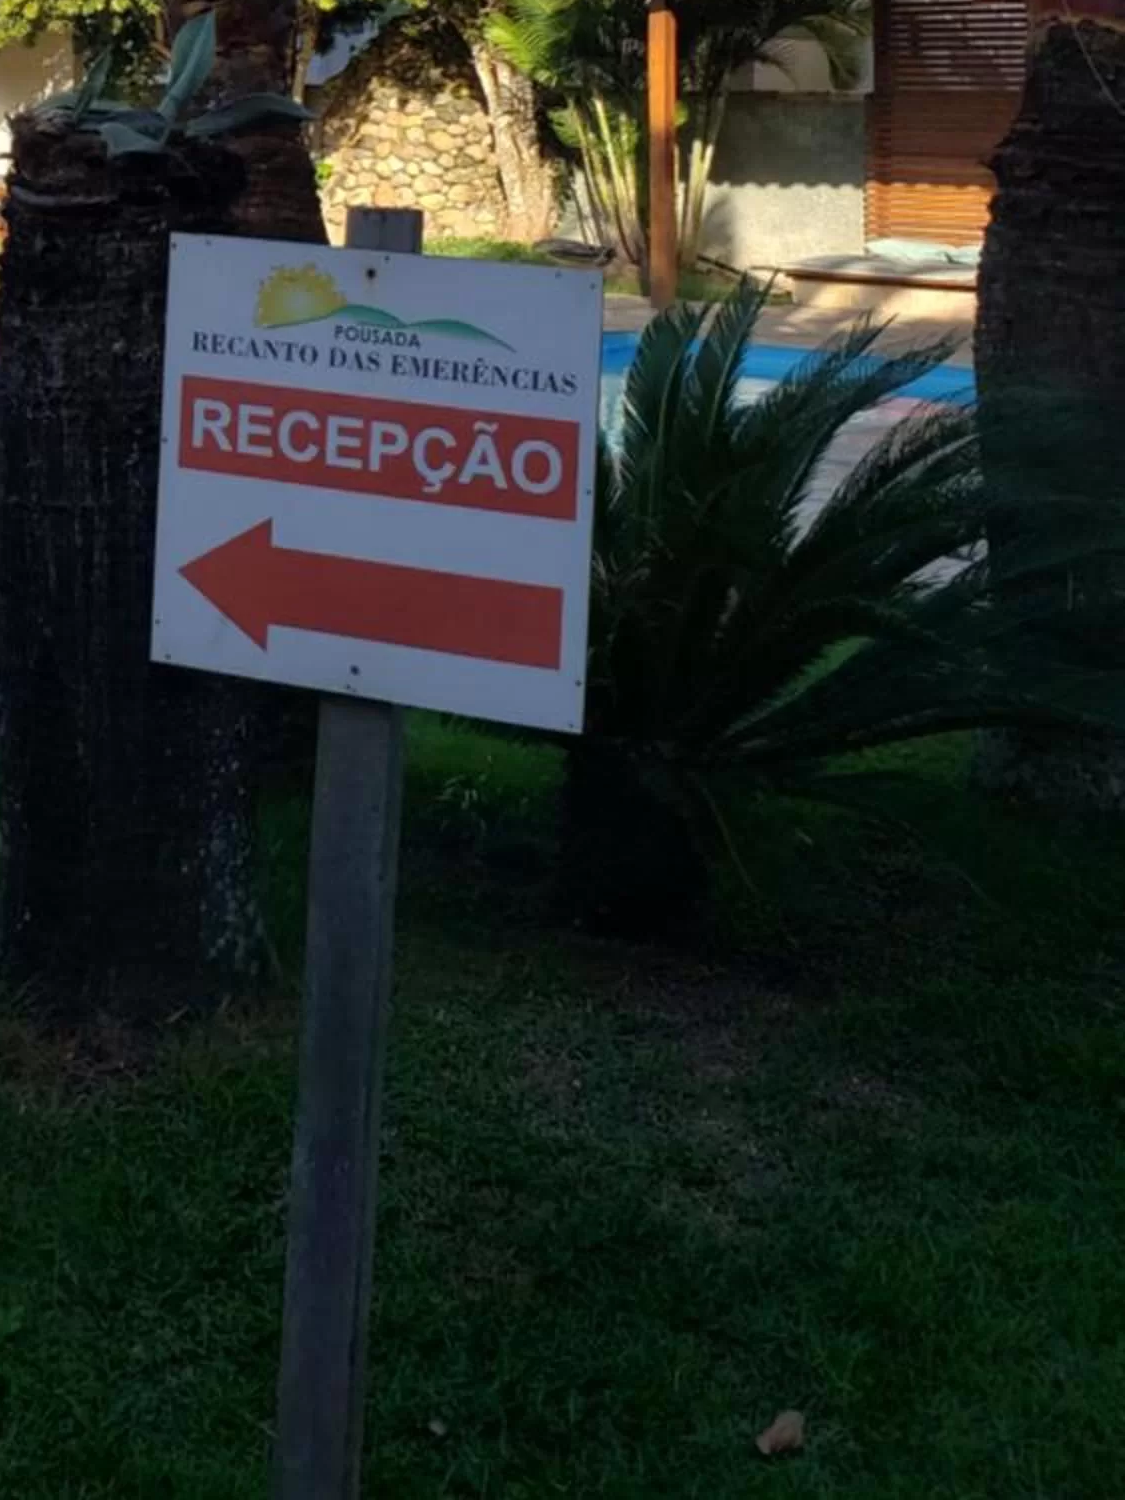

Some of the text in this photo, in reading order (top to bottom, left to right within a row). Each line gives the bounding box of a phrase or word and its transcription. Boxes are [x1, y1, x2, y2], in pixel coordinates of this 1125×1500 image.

[191, 330, 578, 395] RECANTO DAS EMERÊNCIAS
[334, 325, 421, 349] POUSADA
[192, 399, 562, 494] RECEPÇÃO
